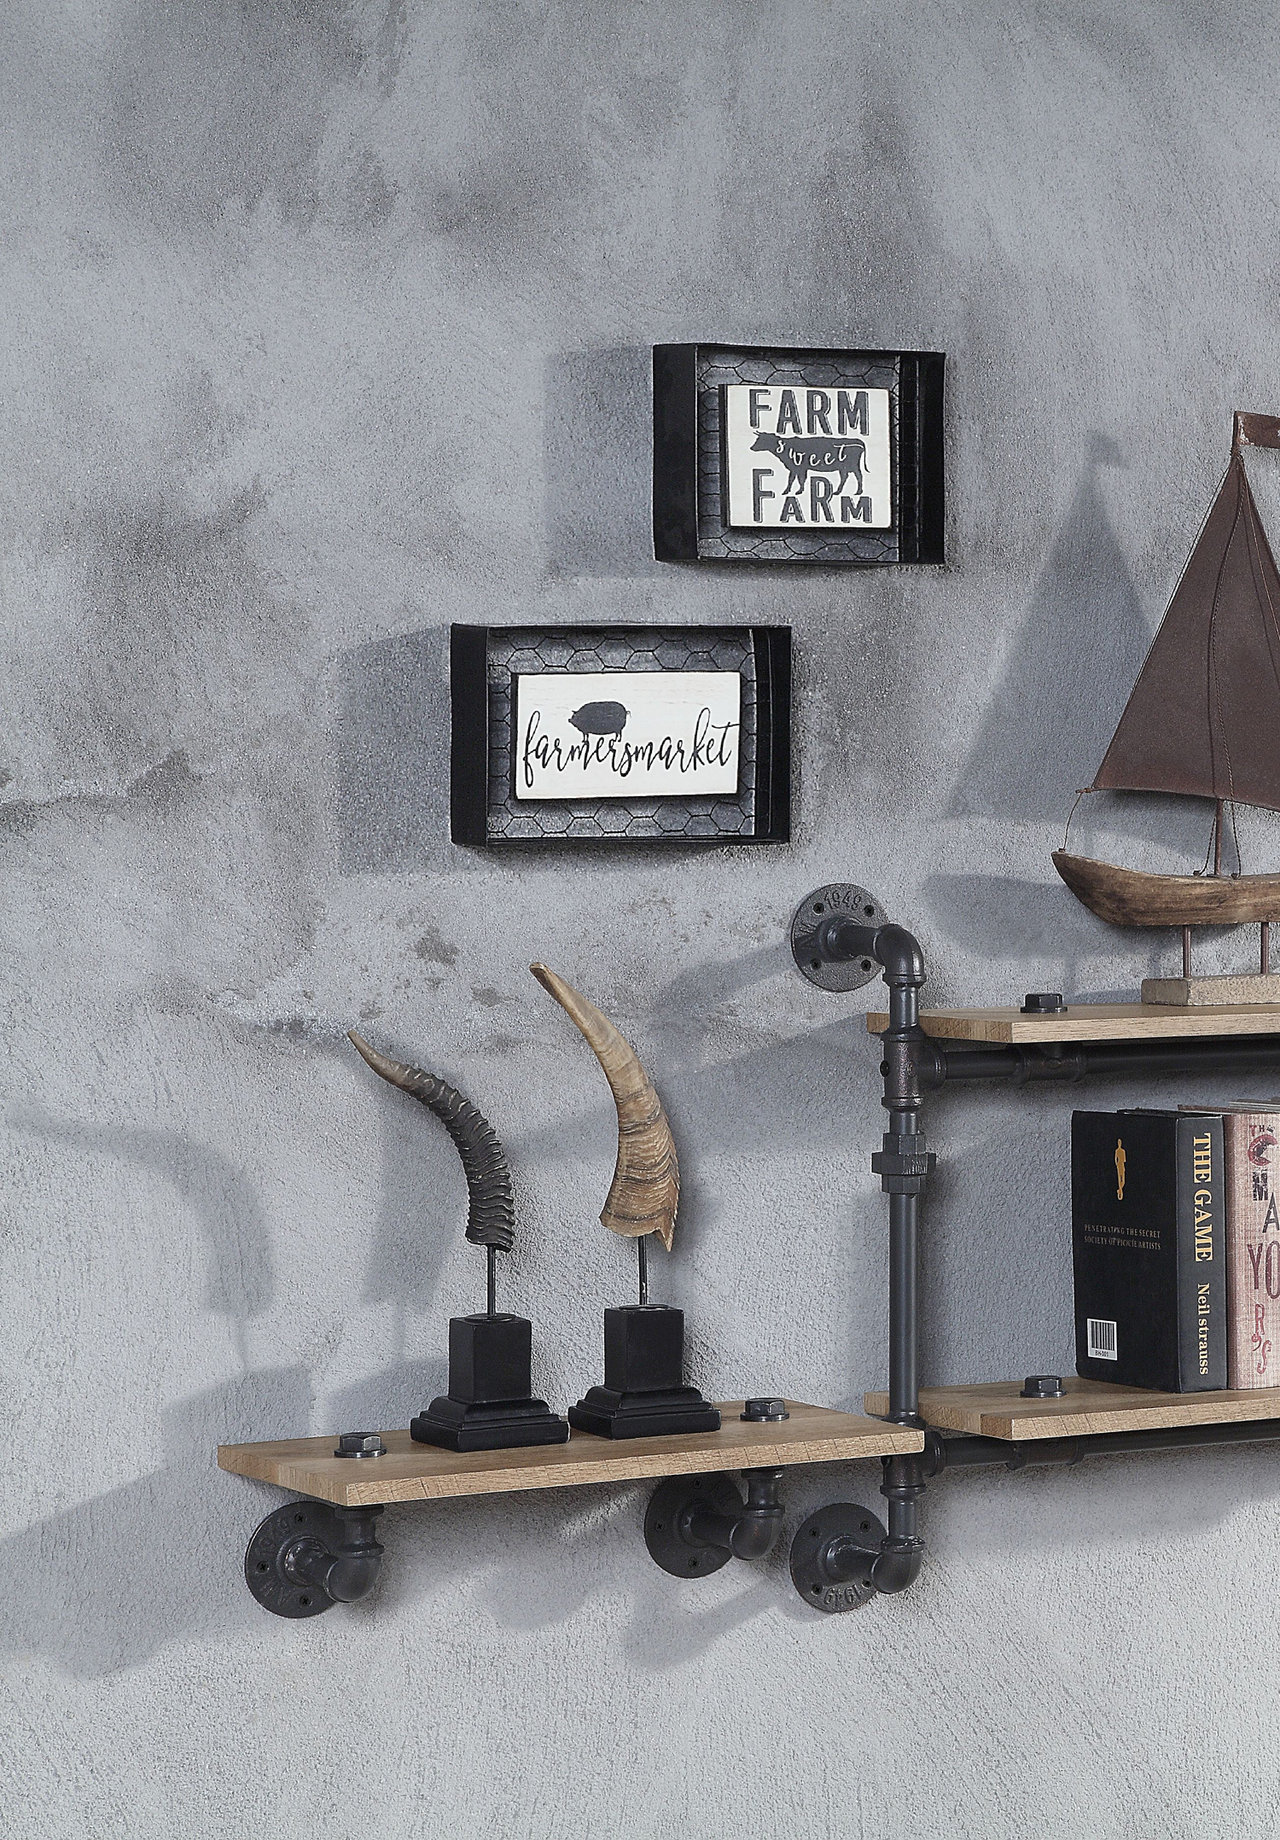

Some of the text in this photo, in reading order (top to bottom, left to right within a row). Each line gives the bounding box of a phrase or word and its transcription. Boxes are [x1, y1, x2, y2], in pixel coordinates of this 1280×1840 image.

[749, 389, 869, 436] FARM
[776, 440, 863, 466] sweet
[752, 468, 872, 523] FARM
[523, 707, 740, 788] farmersmarket
[824, 889, 862, 911] 1949
[1193, 1132, 1213, 1375] THE GAME Neil strauss
